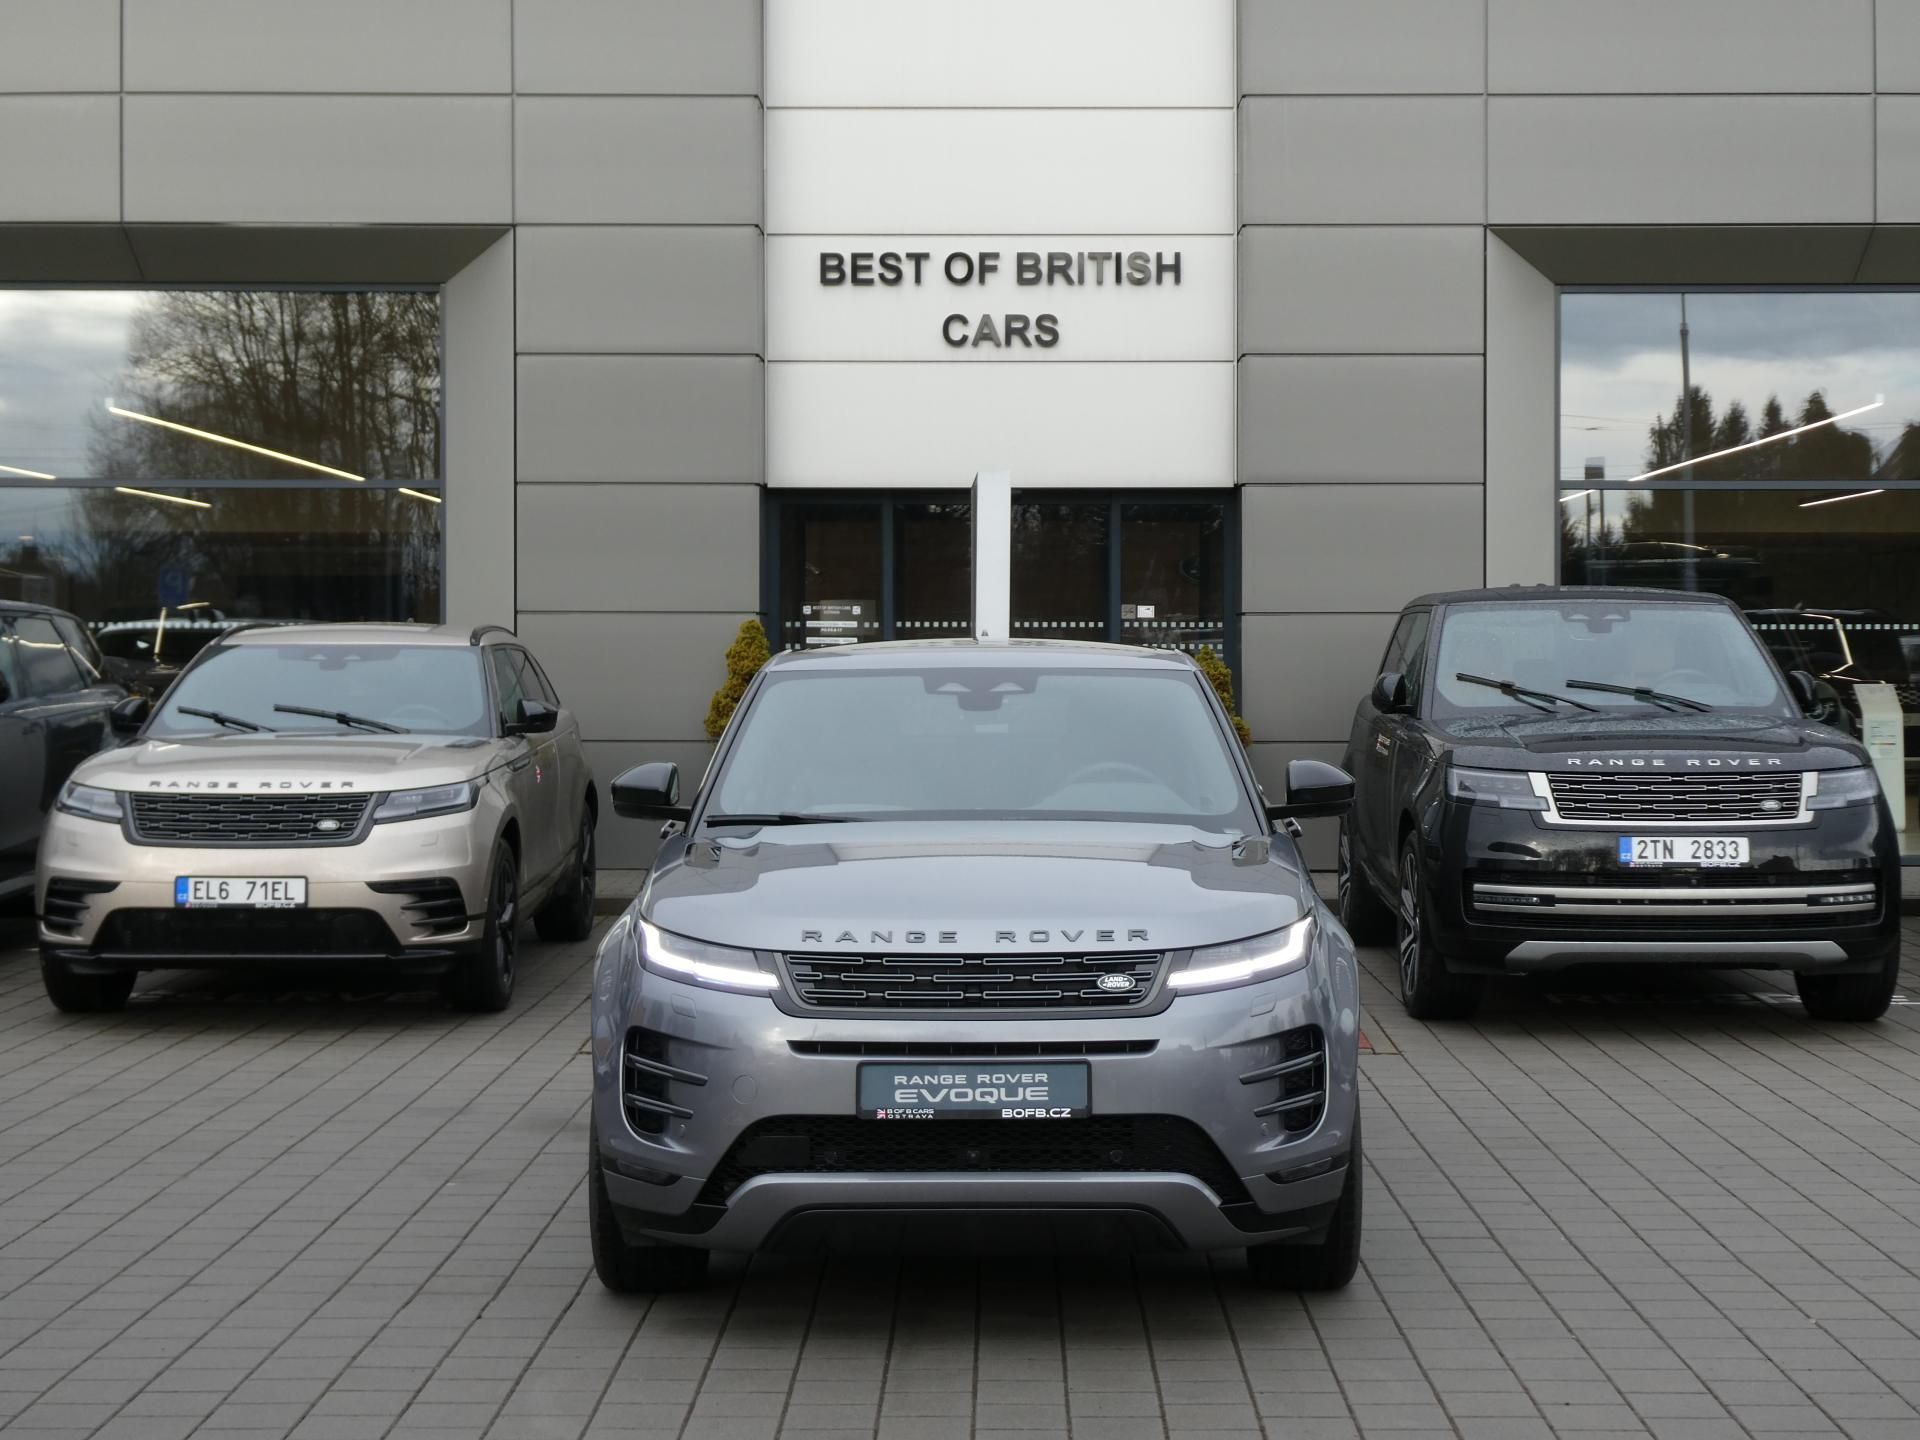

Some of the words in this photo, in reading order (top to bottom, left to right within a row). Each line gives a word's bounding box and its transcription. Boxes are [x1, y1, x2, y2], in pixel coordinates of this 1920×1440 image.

[820, 252, 930, 286] BEST
[944, 252, 1000, 286] OF
[1016, 252, 1182, 286] BRITISH
[942, 313, 1060, 347] CARS
[1567, 758, 1666, 766] RANGE
[1687, 758, 1782, 766] ROVER
[149, 781, 239, 789] RANGE
[259, 781, 354, 789] ROVER
[1637, 839, 1674, 860] 2TN
[1690, 839, 1740, 860] 2833
[193, 880, 230, 900] EL6
[246, 881, 296, 901] 71EL
[800, 929, 958, 944] RANGE
[995, 928, 1150, 944] ROVER
[894, 1074, 967, 1085] RANGE
[976, 1073, 1049, 1084] ROVER
[894, 1086, 1049, 1104] EVOQUE
[1001, 1107, 1072, 1118] BOFB.CZ
